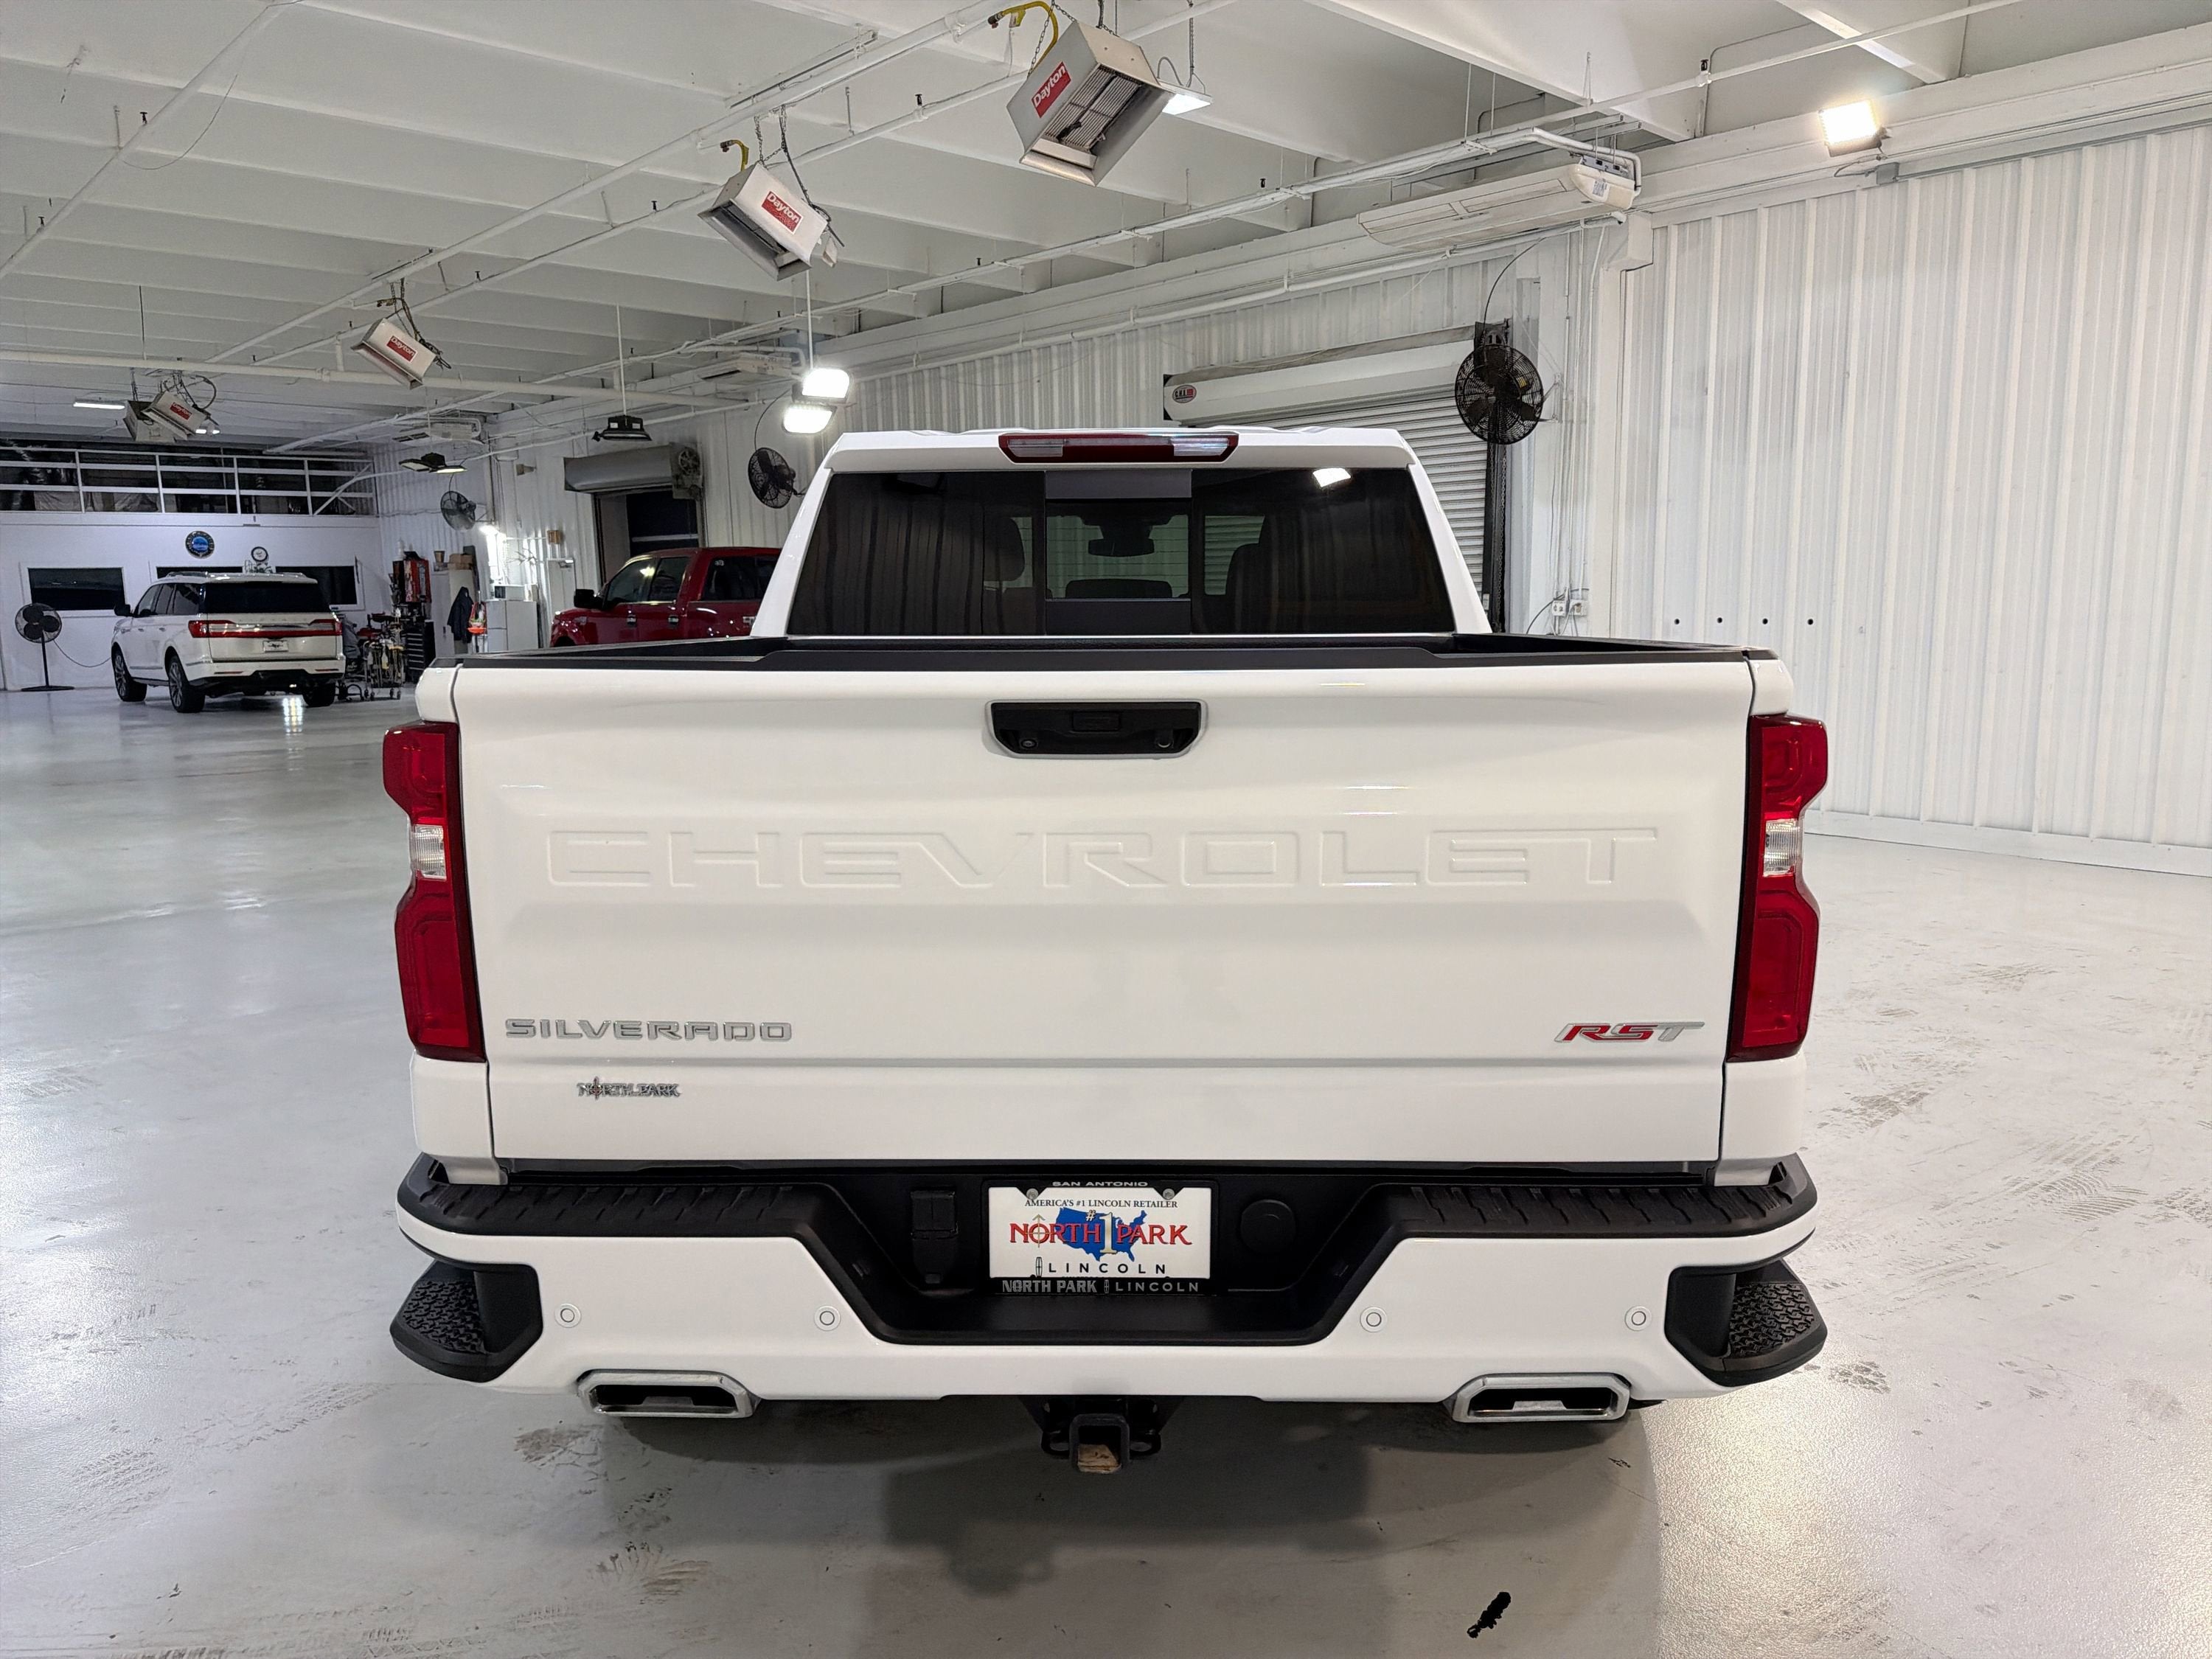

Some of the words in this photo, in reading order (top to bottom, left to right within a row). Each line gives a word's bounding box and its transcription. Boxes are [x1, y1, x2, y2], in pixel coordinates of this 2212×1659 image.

[1033, 66, 1065, 108] Dayton
[767, 193, 799, 223] Dayton
[391, 337, 414, 356] Dayton
[547, 827, 1658, 886] CHEVROLET
[505, 1018, 792, 1041] SILVERADO
[1554, 1022, 1705, 1043] RST
[577, 1080, 633, 1099] NORTH
[637, 1083, 682, 1097] PARK
[1025, 1199, 1074, 1207] AMERICA'S
[1133, 1200, 1178, 1208] RETAILER
[1009, 1222, 1101, 1245] NORTH
[1116, 1224, 1192, 1245] PARK
[1048, 1262, 1166, 1274] LINCOLN
[1002, 1280, 1051, 1293] NORTH
[1057, 1280, 1097, 1293] PARK
[1115, 1282, 1198, 1292] LINCOLN
